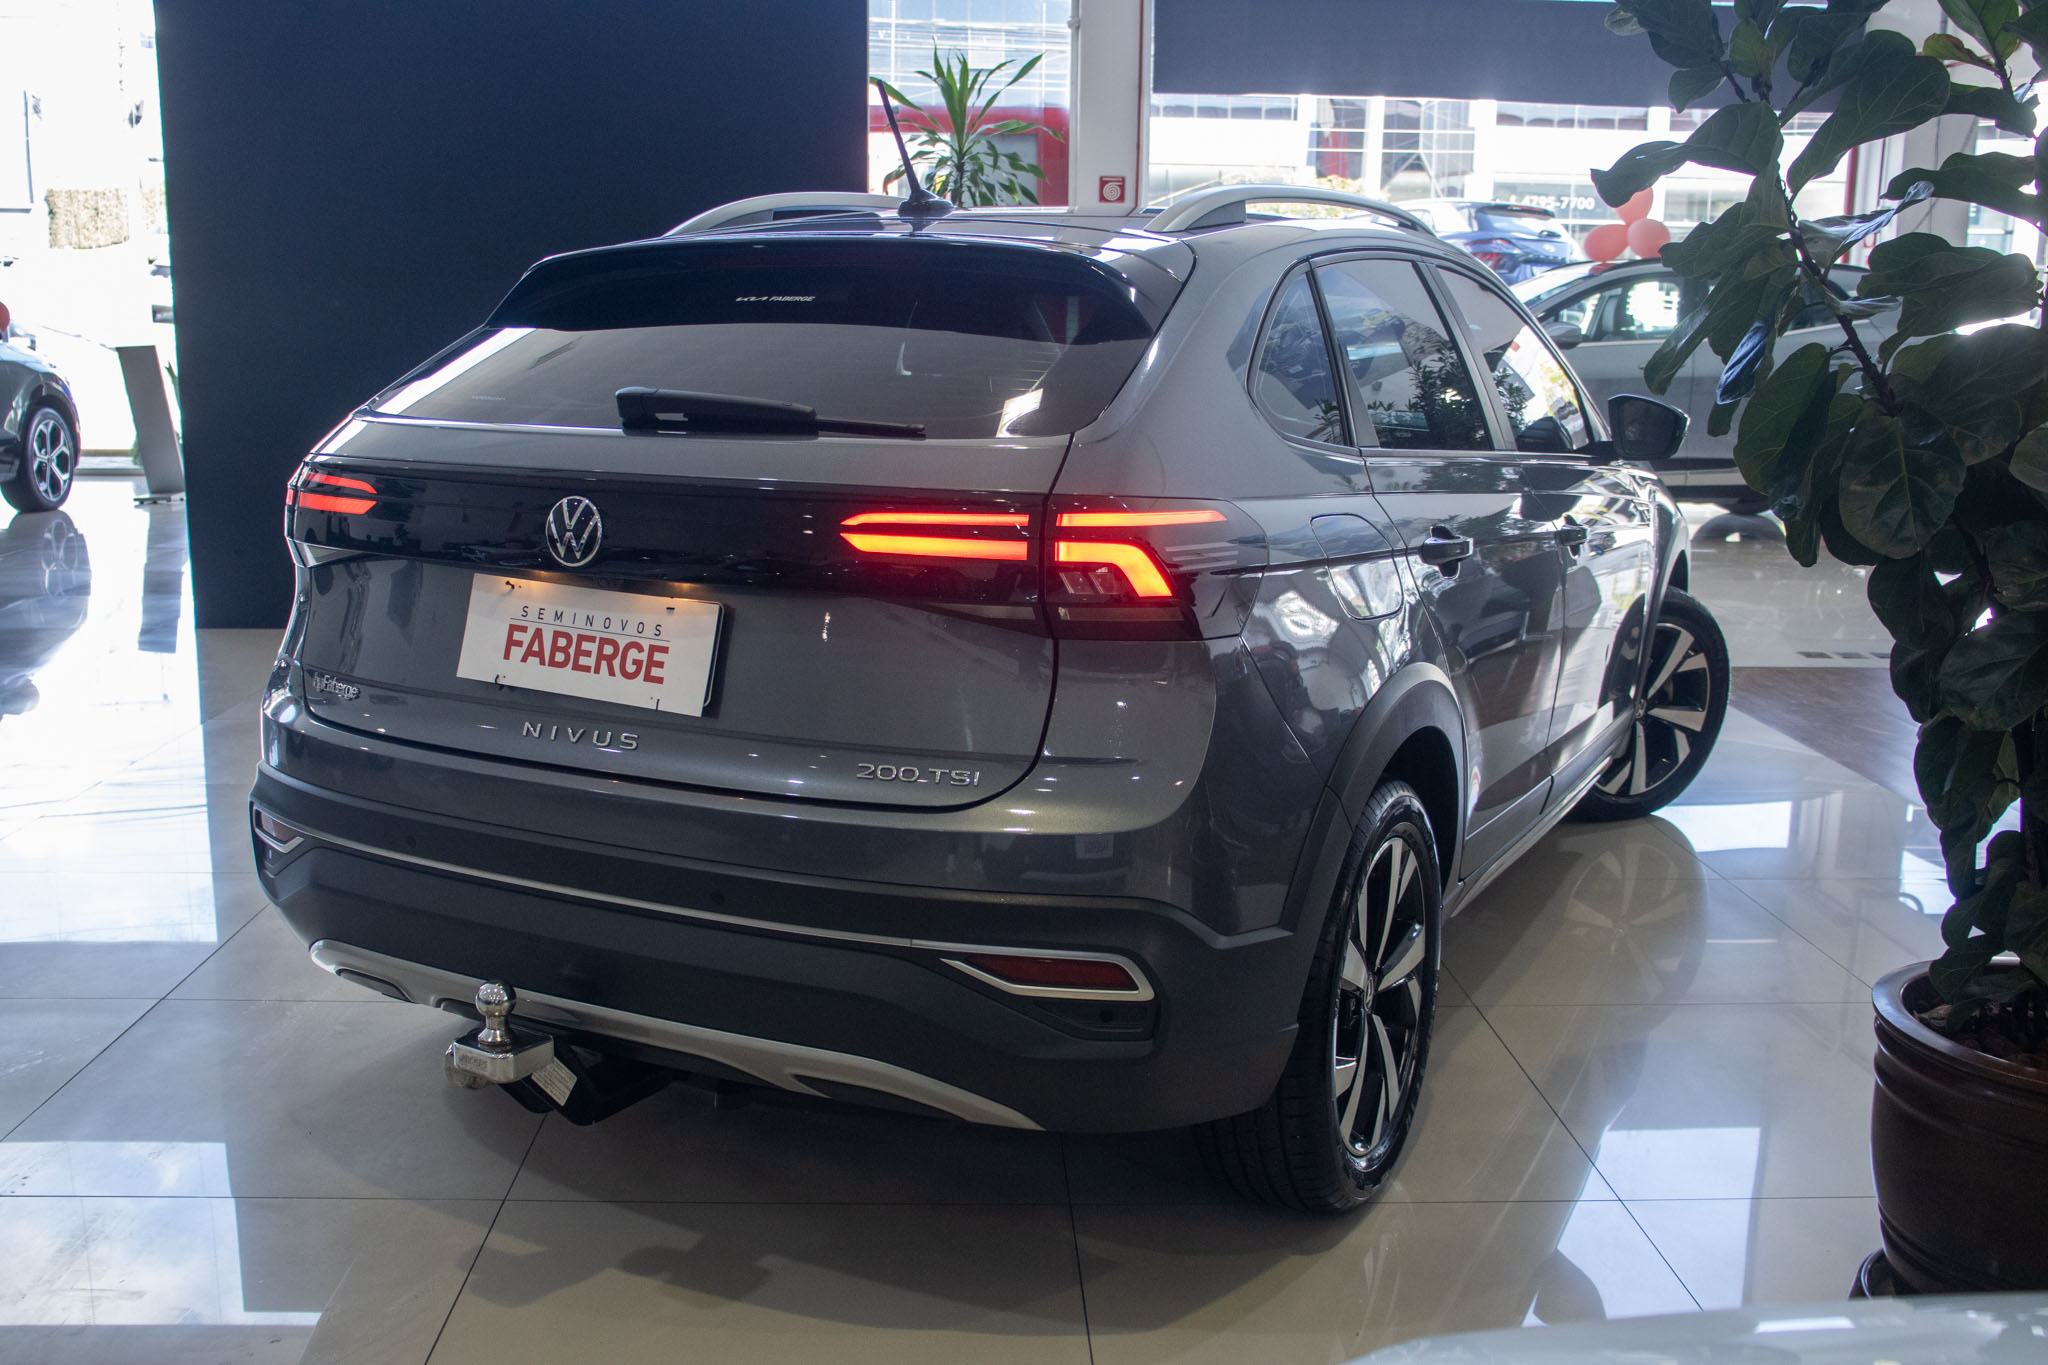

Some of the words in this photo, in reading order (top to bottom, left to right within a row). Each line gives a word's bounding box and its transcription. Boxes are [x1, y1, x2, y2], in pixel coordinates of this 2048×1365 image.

[520, 605, 663, 637] SEMINOVOS
[503, 623, 670, 685] FABERGE
[522, 721, 640, 750] NIVUS
[856, 763, 920, 782] 200
[928, 768, 980, 786] TSI
